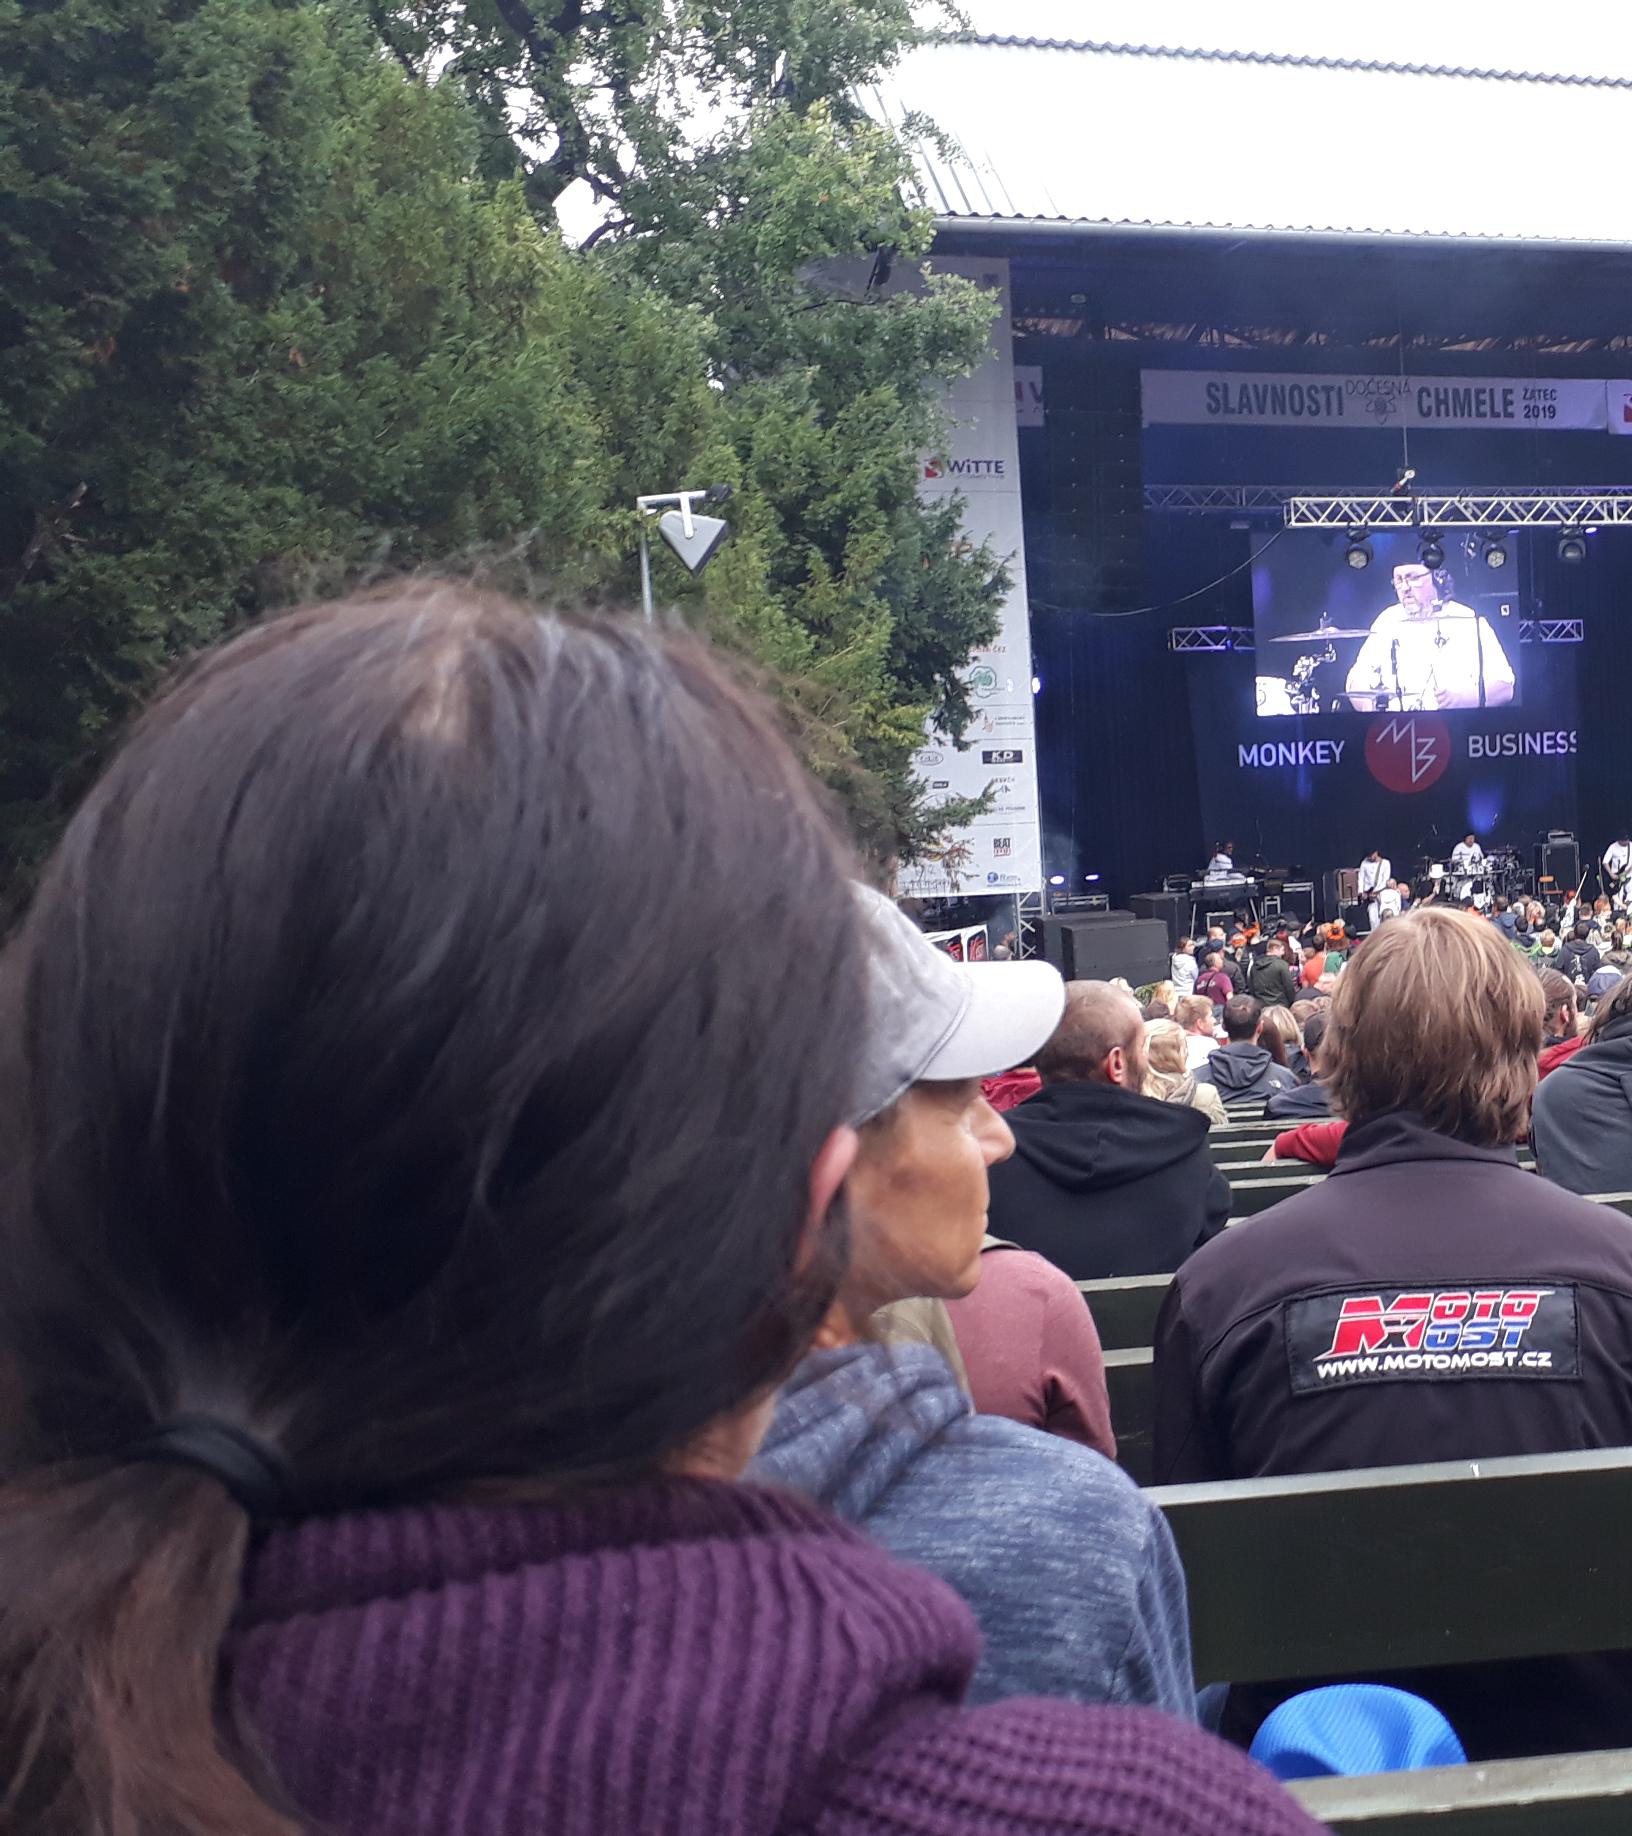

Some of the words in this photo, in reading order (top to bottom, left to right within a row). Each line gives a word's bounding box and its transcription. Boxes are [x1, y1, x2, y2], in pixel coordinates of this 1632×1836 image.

[1205, 381, 1345, 417] SLAVNOSTI
[1417, 386, 1515, 418] CHMELE
[1523, 403, 1556, 419] 2019
[1238, 740, 1345, 768] MONKEY
[1316, 1351, 1552, 1378] WWW.MOTOMOST.CZ
